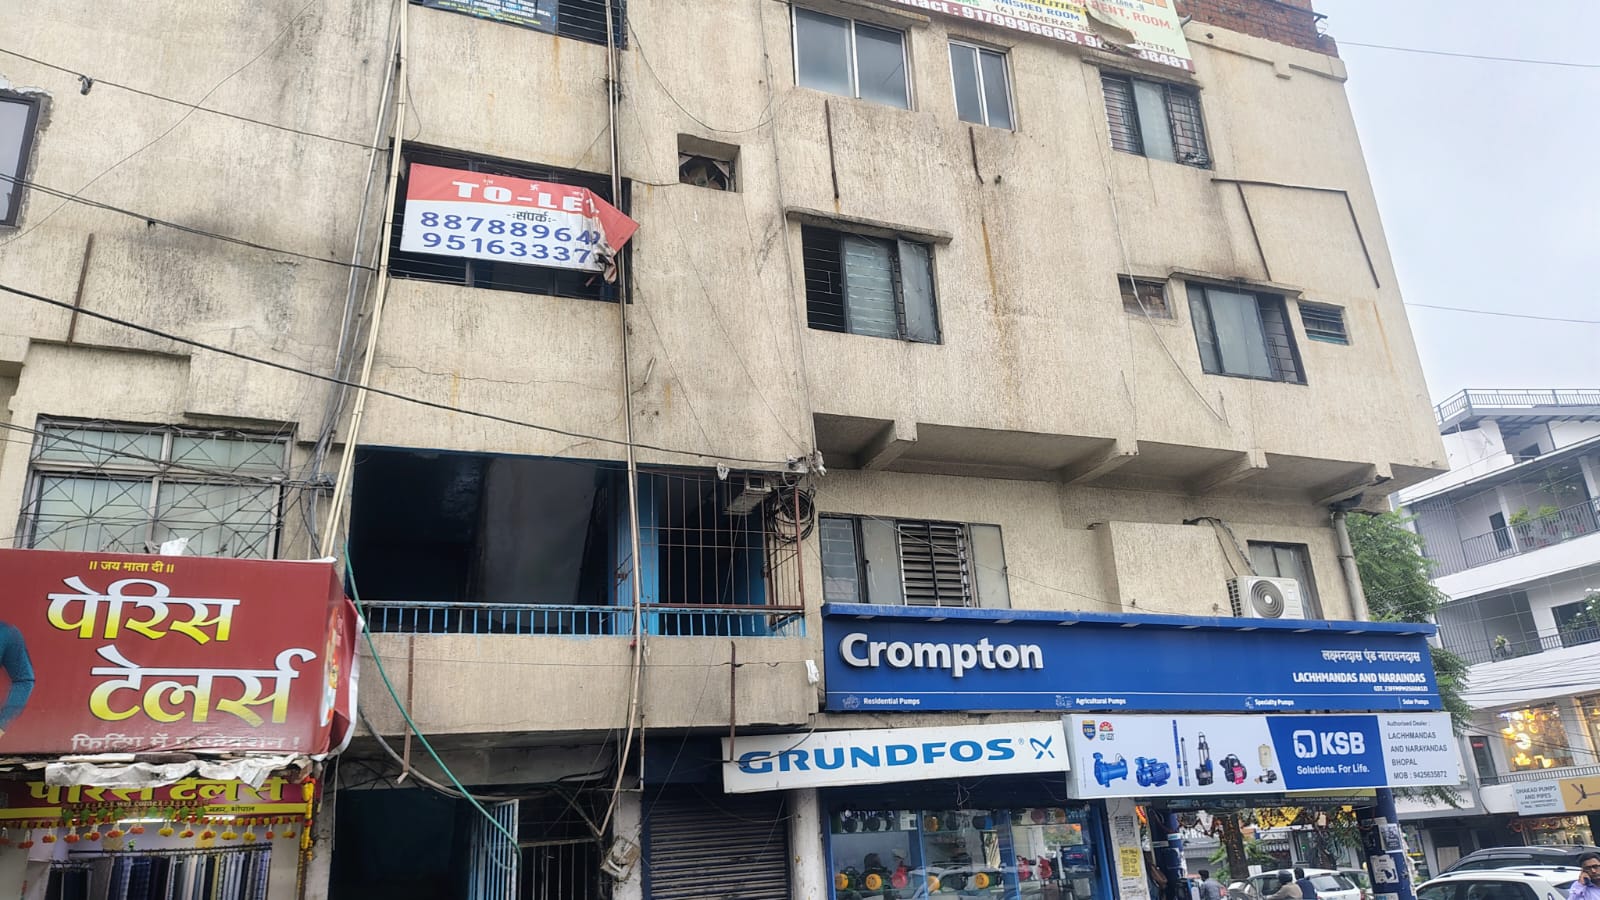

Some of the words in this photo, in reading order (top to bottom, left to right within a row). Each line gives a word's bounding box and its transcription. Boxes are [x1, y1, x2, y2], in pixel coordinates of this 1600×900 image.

[1019, 11, 1073, 28] CAMERAS
[1046, 8, 1080, 21] ROOM
[100, 561, 121, 571] जय
[123, 562, 150, 572] माता
[151, 560, 164, 573] दी
[47, 576, 241, 645] पेरिस
[839, 632, 1045, 678] Crompton
[1293, 672, 1358, 683] LACHHMANDAS
[1359, 672, 1377, 683] AND
[1378, 672, 1427, 683] NARAINDAS
[89, 644, 317, 728] टेलर्स
[863, 696, 899, 705] Residential
[899, 697, 921, 706] Pumps
[1075, 697, 1107, 706] Agricultural
[1108, 697, 1127, 706] Pumps
[1255, 698, 1277, 707] Specialty
[1277, 698, 1295, 707] Pumps
[1414, 698, 1430, 706] Pumps
[150, 732, 169, 748] में
[1387, 732, 1437, 740] LACHHMANDAS
[1319, 731, 1366, 756] KSB
[1405, 744, 1448, 752] NARAYANDAS
[738, 738, 1017, 774] GRUNDFOS
[1391, 758, 1418, 766] BHOPAL
[1297, 765, 1337, 775] Solutions.
[1338, 765, 1352, 774] For
[1352, 763, 1370, 774] Life.
[1393, 771, 1409, 779] MOB
